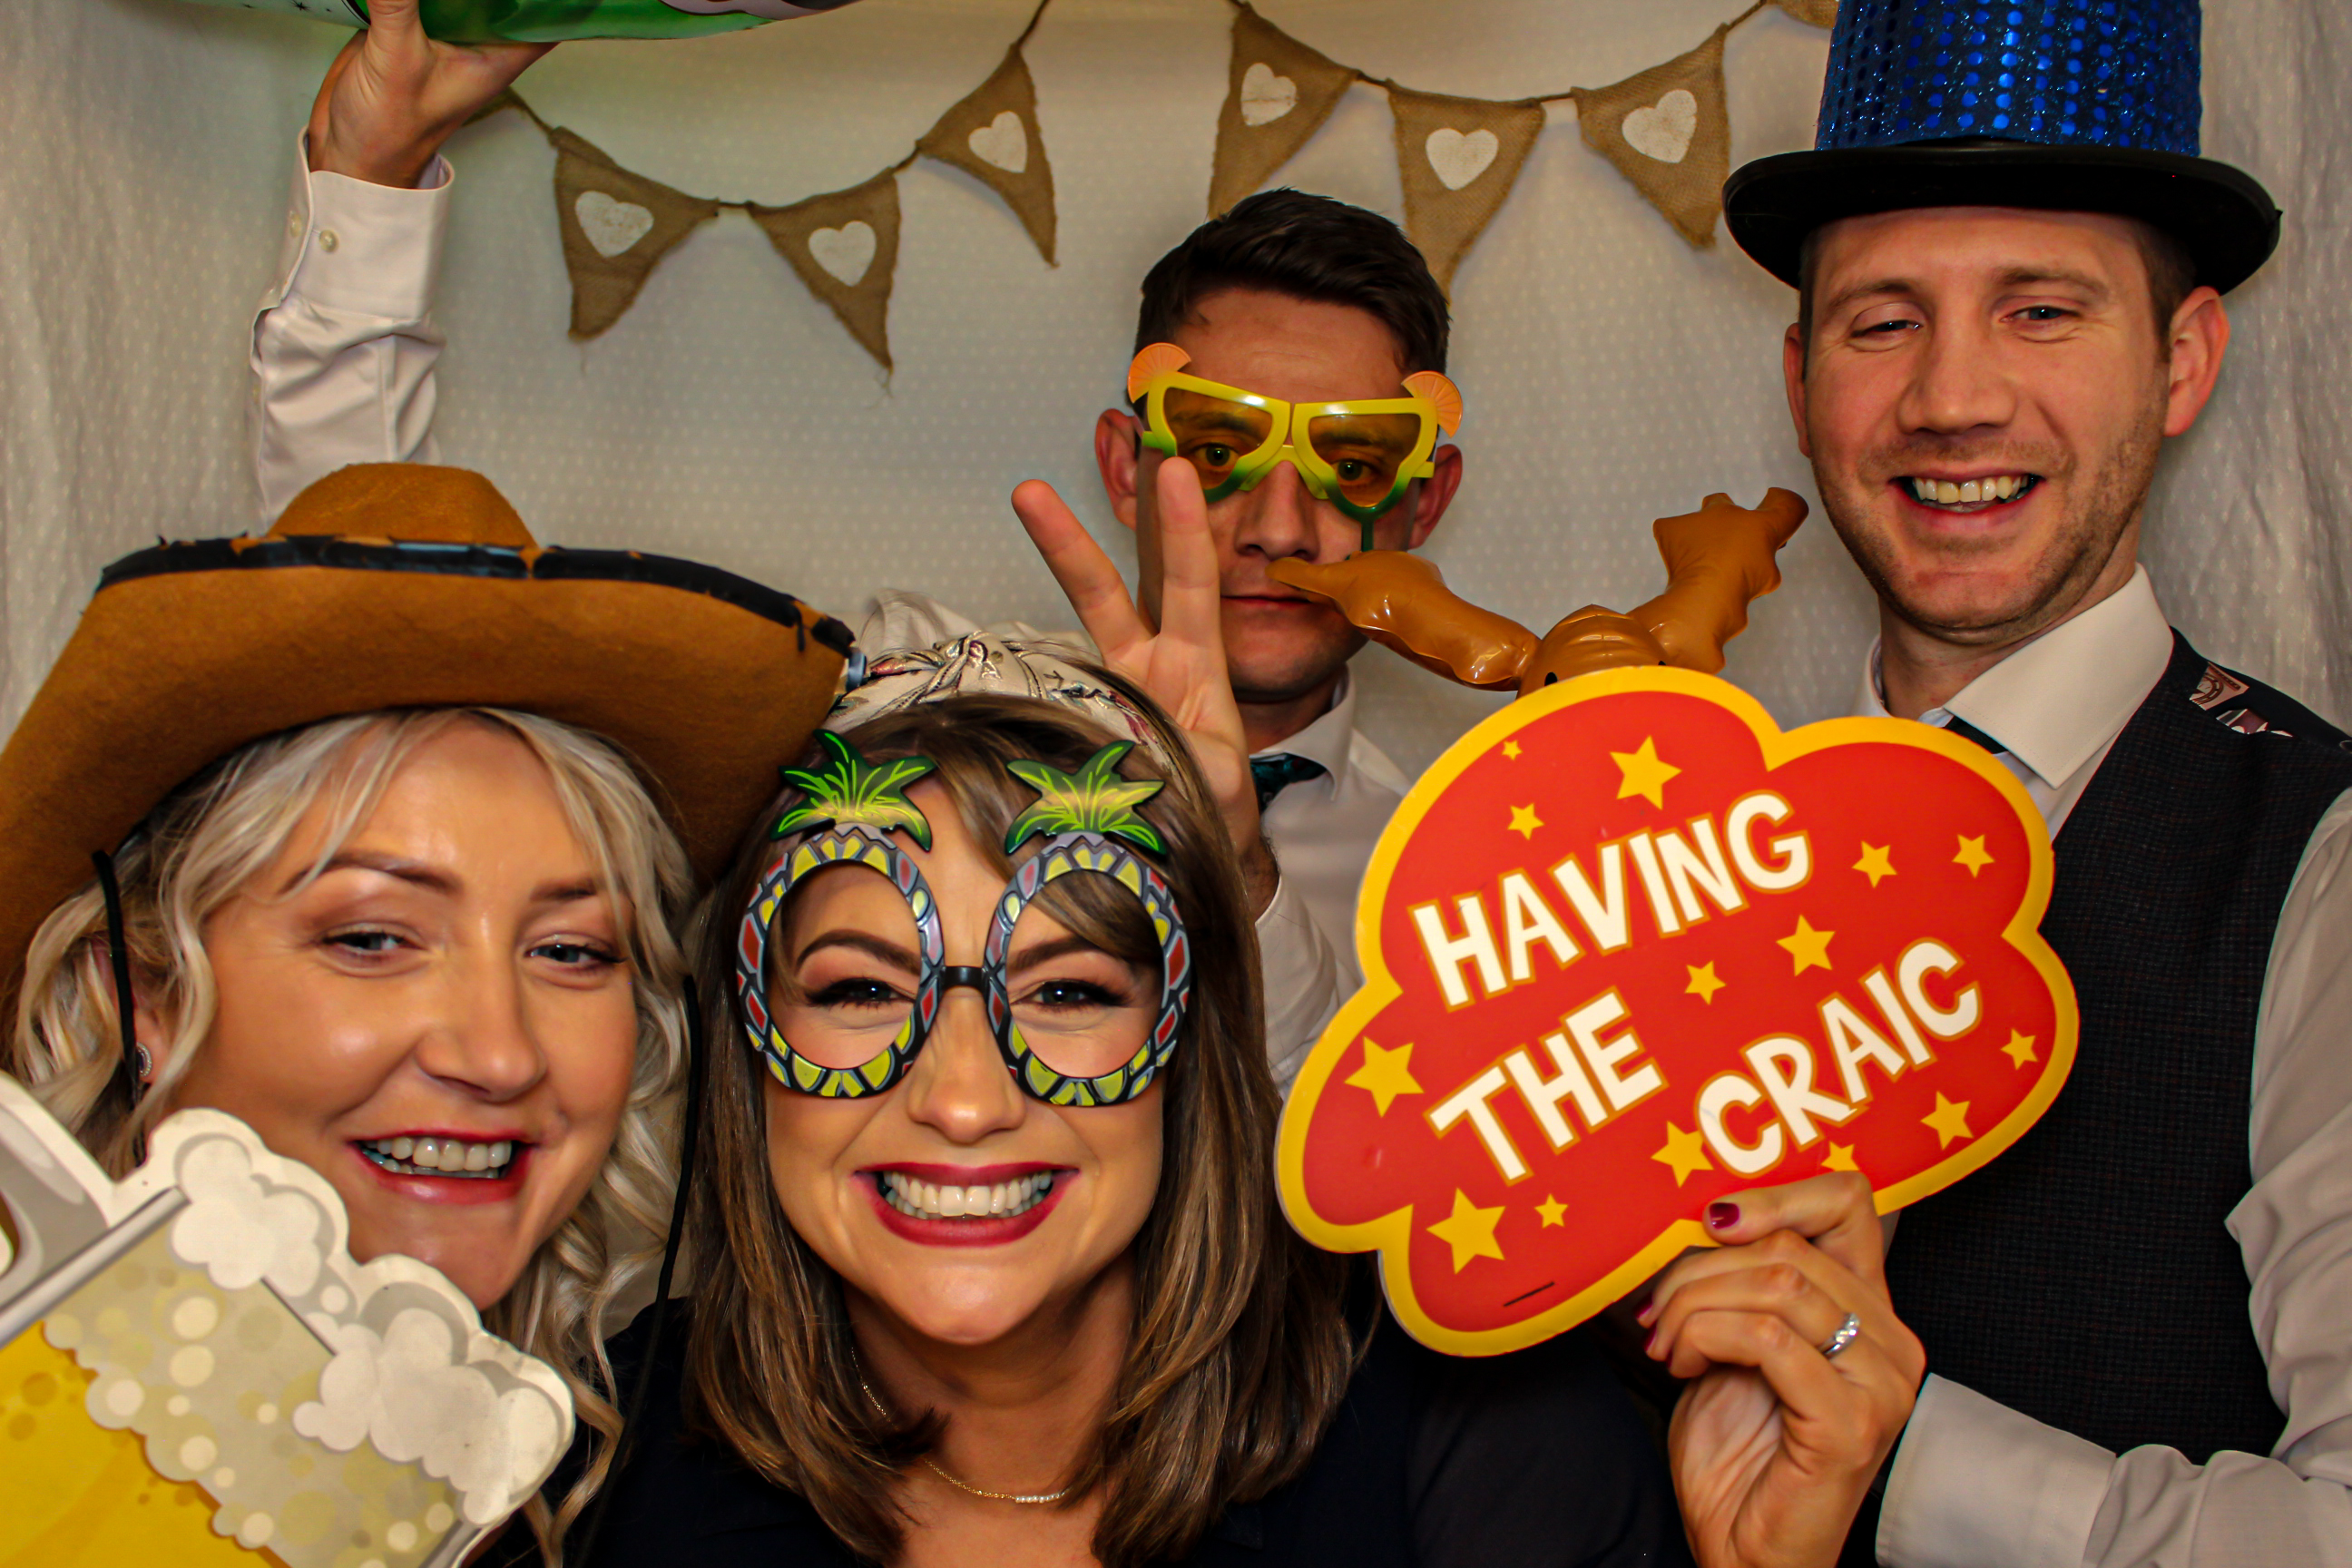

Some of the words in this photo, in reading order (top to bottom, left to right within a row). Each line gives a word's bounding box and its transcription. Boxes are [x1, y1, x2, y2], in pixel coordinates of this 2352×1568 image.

[1411, 792, 1810, 1008] HAVING
[1428, 992, 1664, 1181] THE
[1697, 940, 1980, 1175] CRAIC
